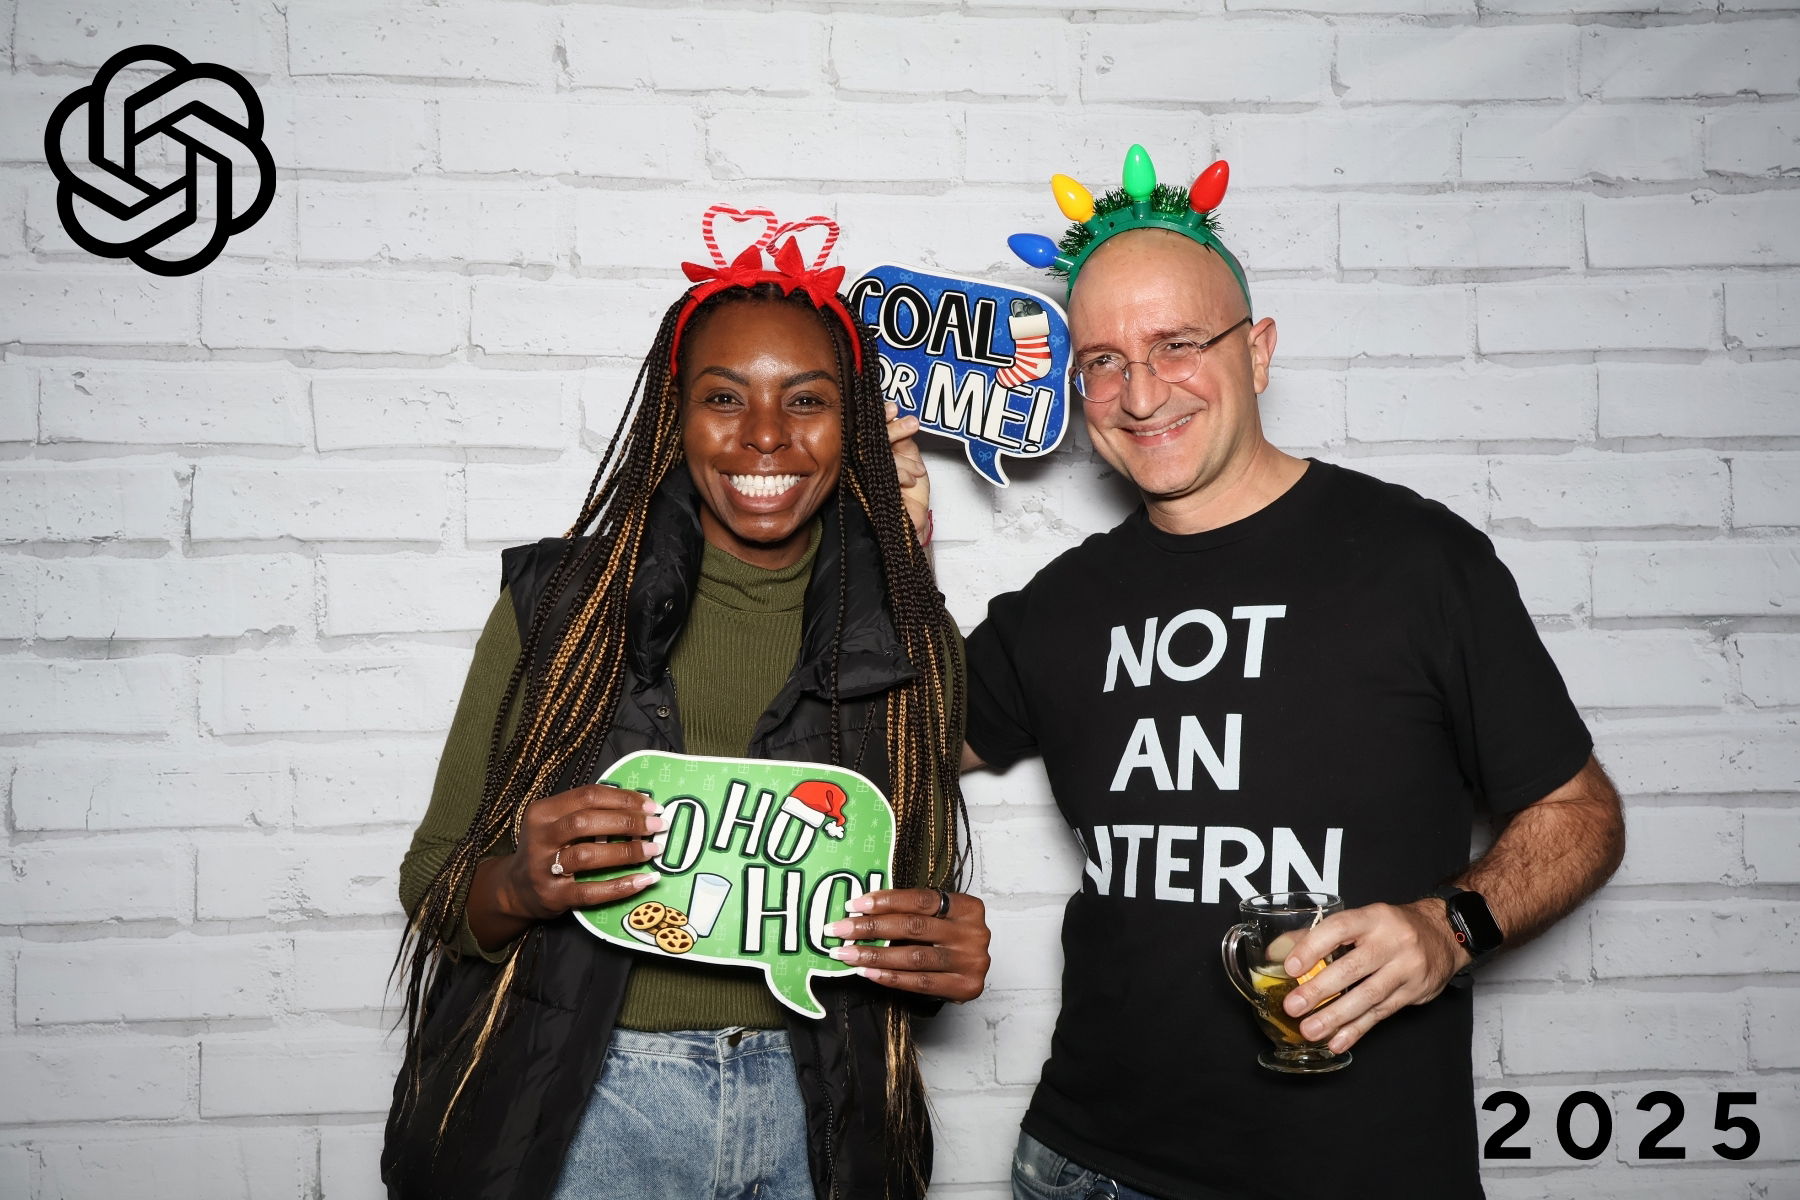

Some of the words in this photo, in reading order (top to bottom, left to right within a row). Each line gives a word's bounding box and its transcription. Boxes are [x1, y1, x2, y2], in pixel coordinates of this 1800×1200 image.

[848, 277, 1015, 367] COAL
[921, 361, 1054, 453] ME!
[1103, 604, 1287, 693] NOT
[1109, 713, 1243, 792] AN
[576, 781, 708, 879] O
[711, 779, 818, 866] HO
[1072, 824, 1344, 905] NTERN
